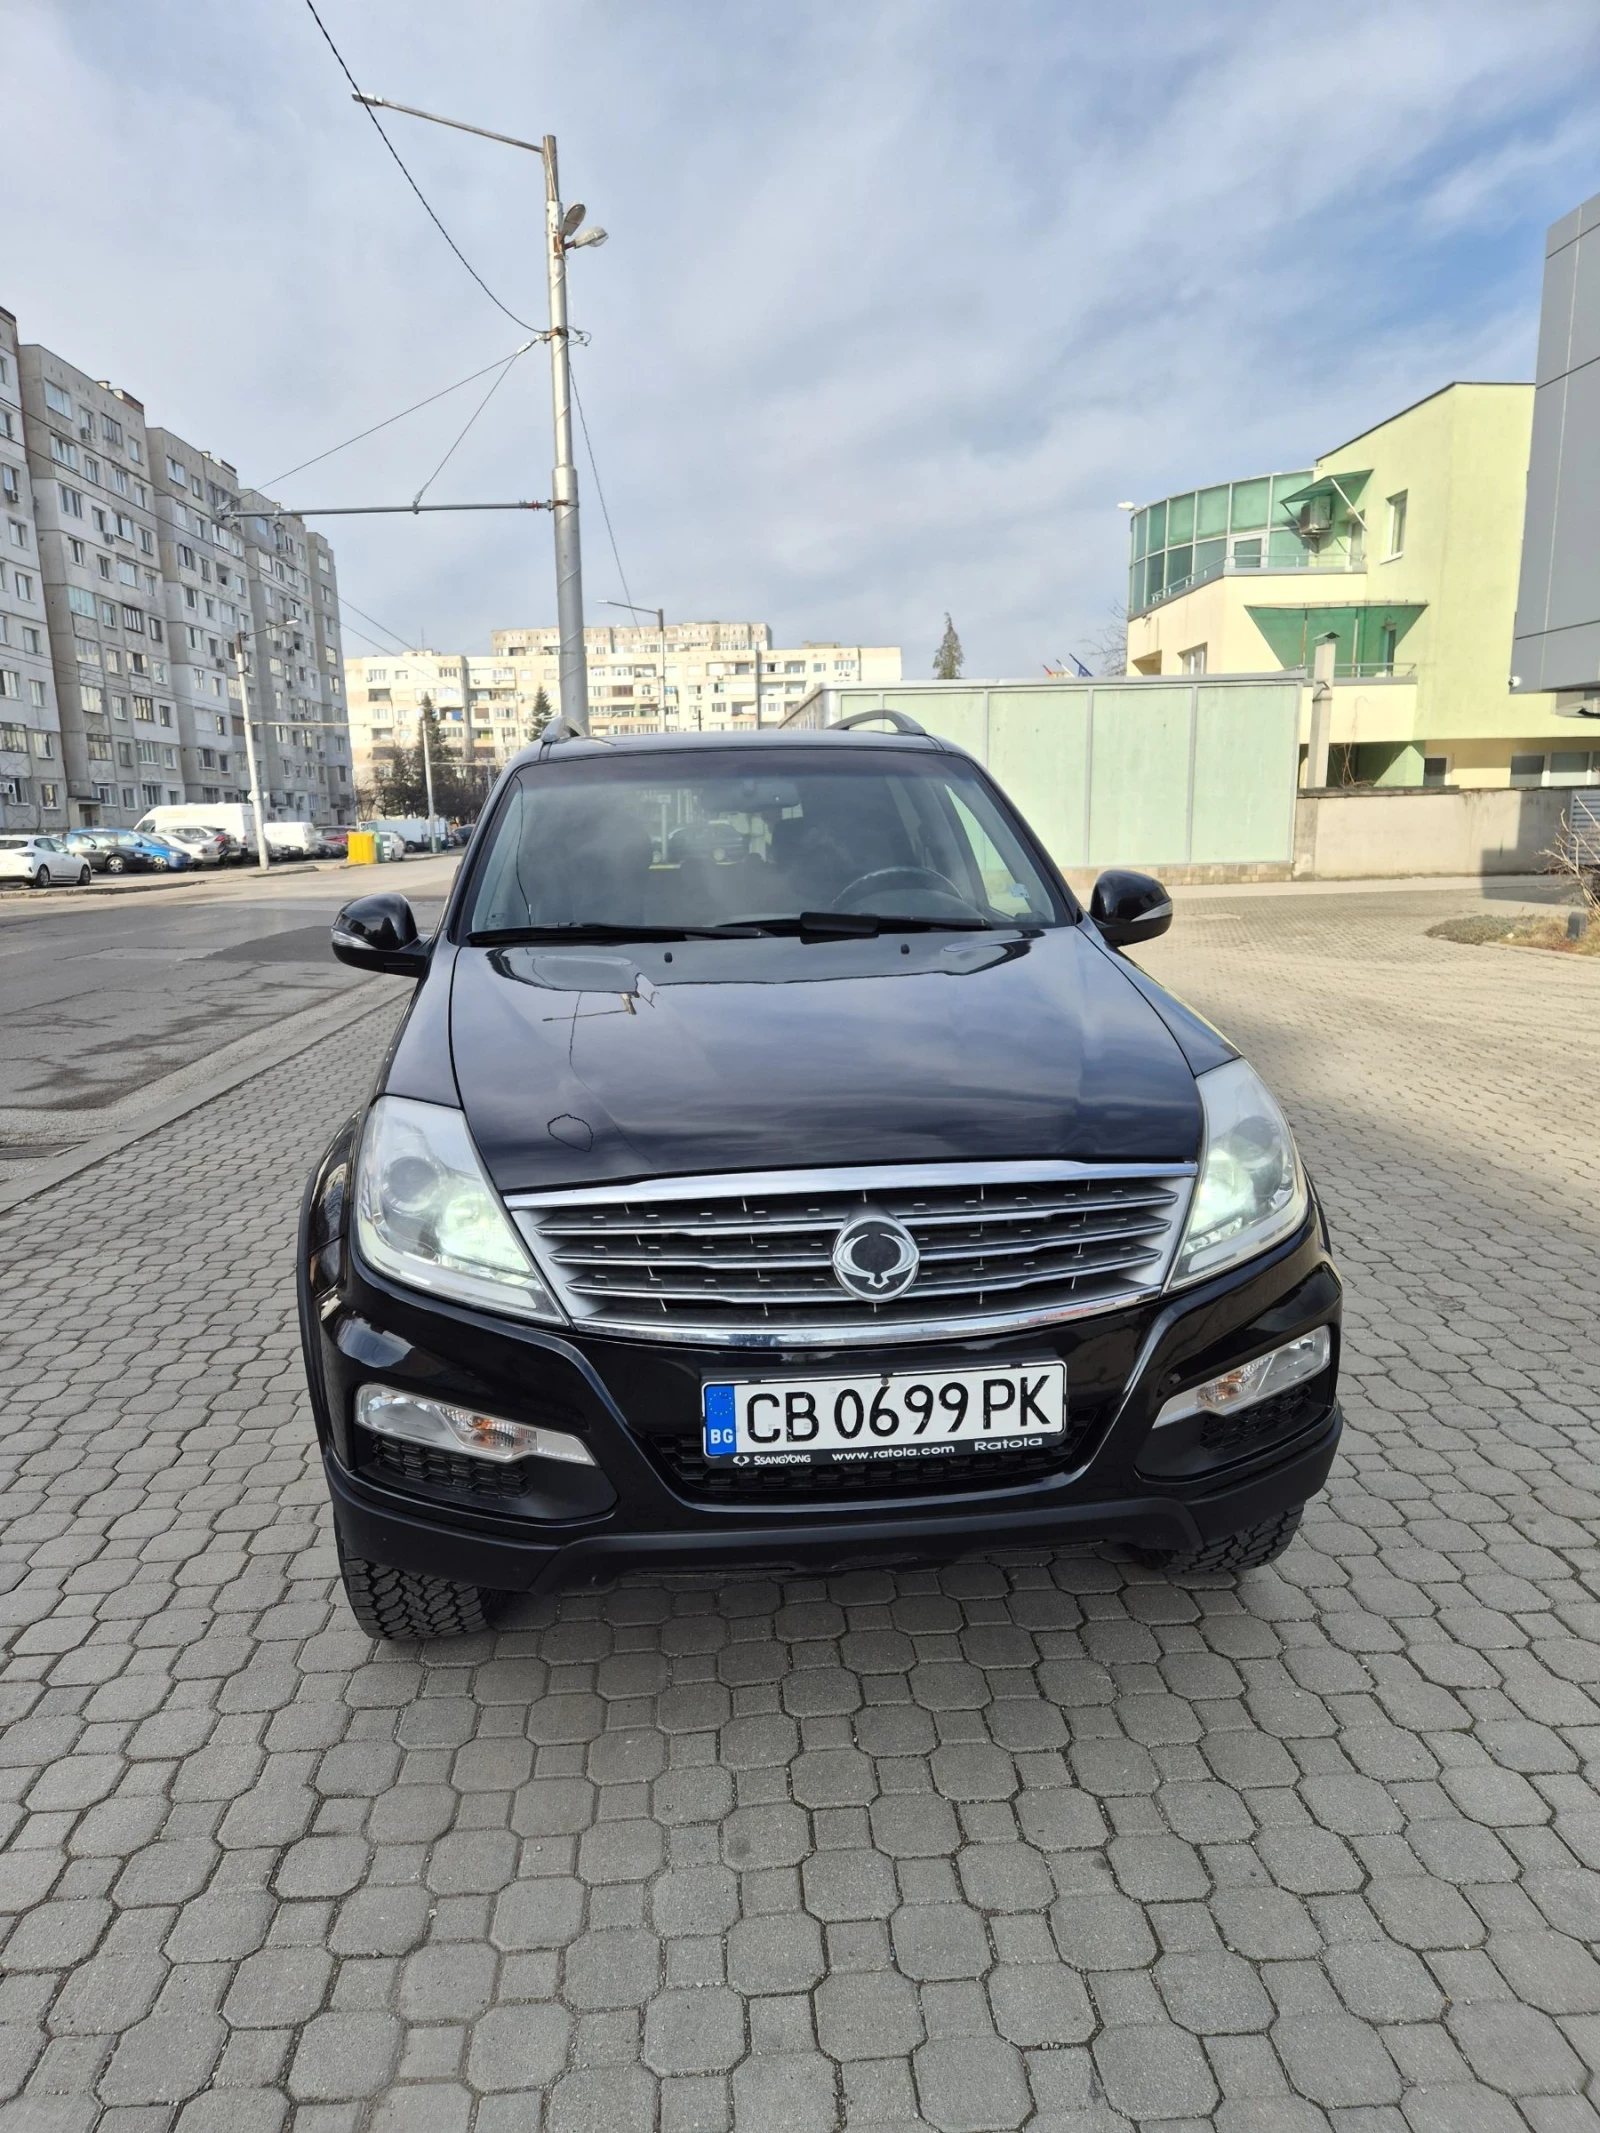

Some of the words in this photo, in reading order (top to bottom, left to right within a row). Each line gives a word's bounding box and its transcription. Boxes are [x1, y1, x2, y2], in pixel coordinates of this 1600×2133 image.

[746, 1392, 820, 1444] CB
[833, 1382, 969, 1440] 0699
[982, 1375, 1051, 1430] PK
[710, 1429, 734, 1445] BG
[973, 1436, 1043, 1452] Ratola
[831, 1443, 956, 1462] www.ratola.com
